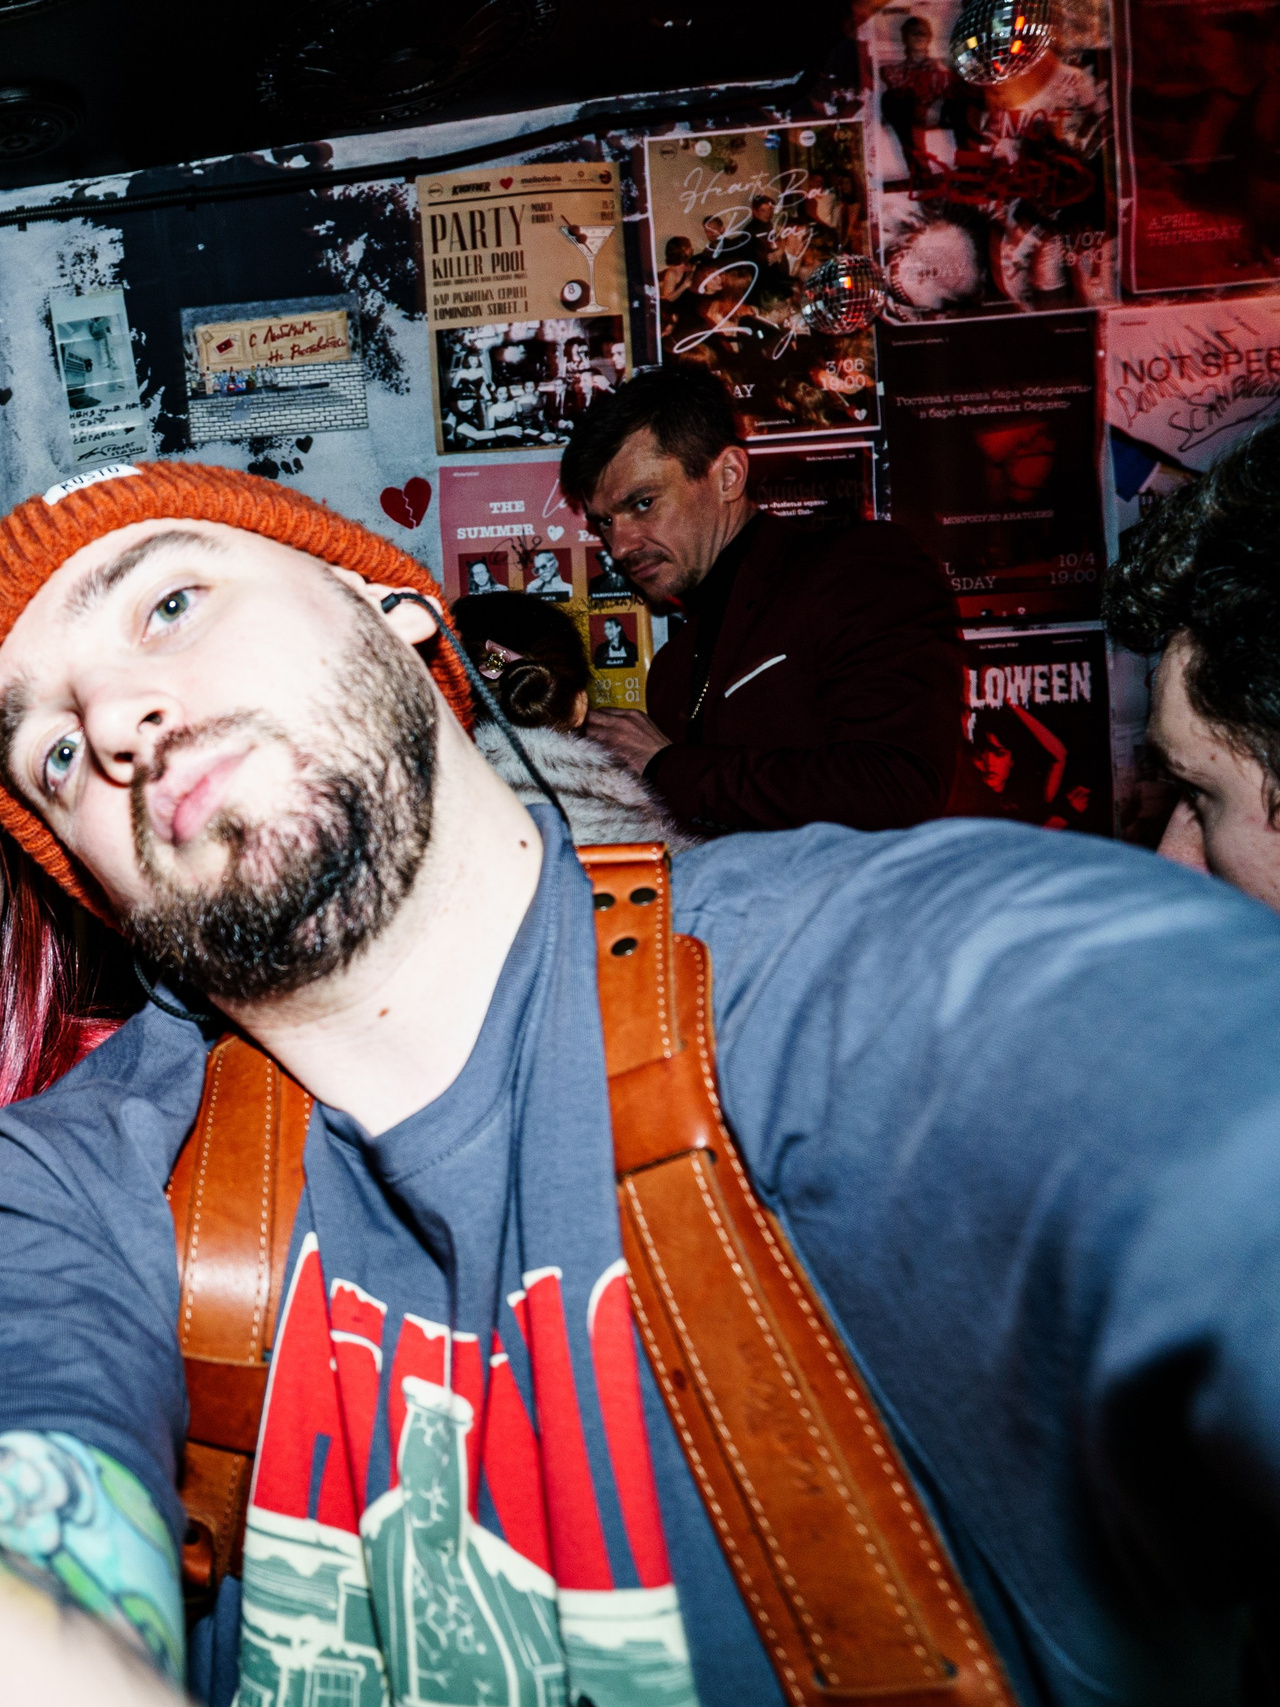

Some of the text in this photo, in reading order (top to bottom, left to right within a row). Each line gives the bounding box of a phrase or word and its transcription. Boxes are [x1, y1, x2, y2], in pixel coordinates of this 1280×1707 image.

[430, 204, 525, 254] PARTY
[705, 206, 820, 260] B-day
[432, 250, 526, 280] KILLER POOL
[567, 284, 576, 295] 8
[1121, 354, 1192, 386] NOT
[489, 500, 526, 515] THE
[456, 523, 536, 541] SUMMER
[1058, 552, 1096, 569] 10/4
[951, 576, 997, 592] SDAY
[1049, 569, 1098, 585] 19:00
[624, 677, 640, 690] 01
[967, 660, 1092, 711] LOWEEN
[624, 690, 640, 703] 01
